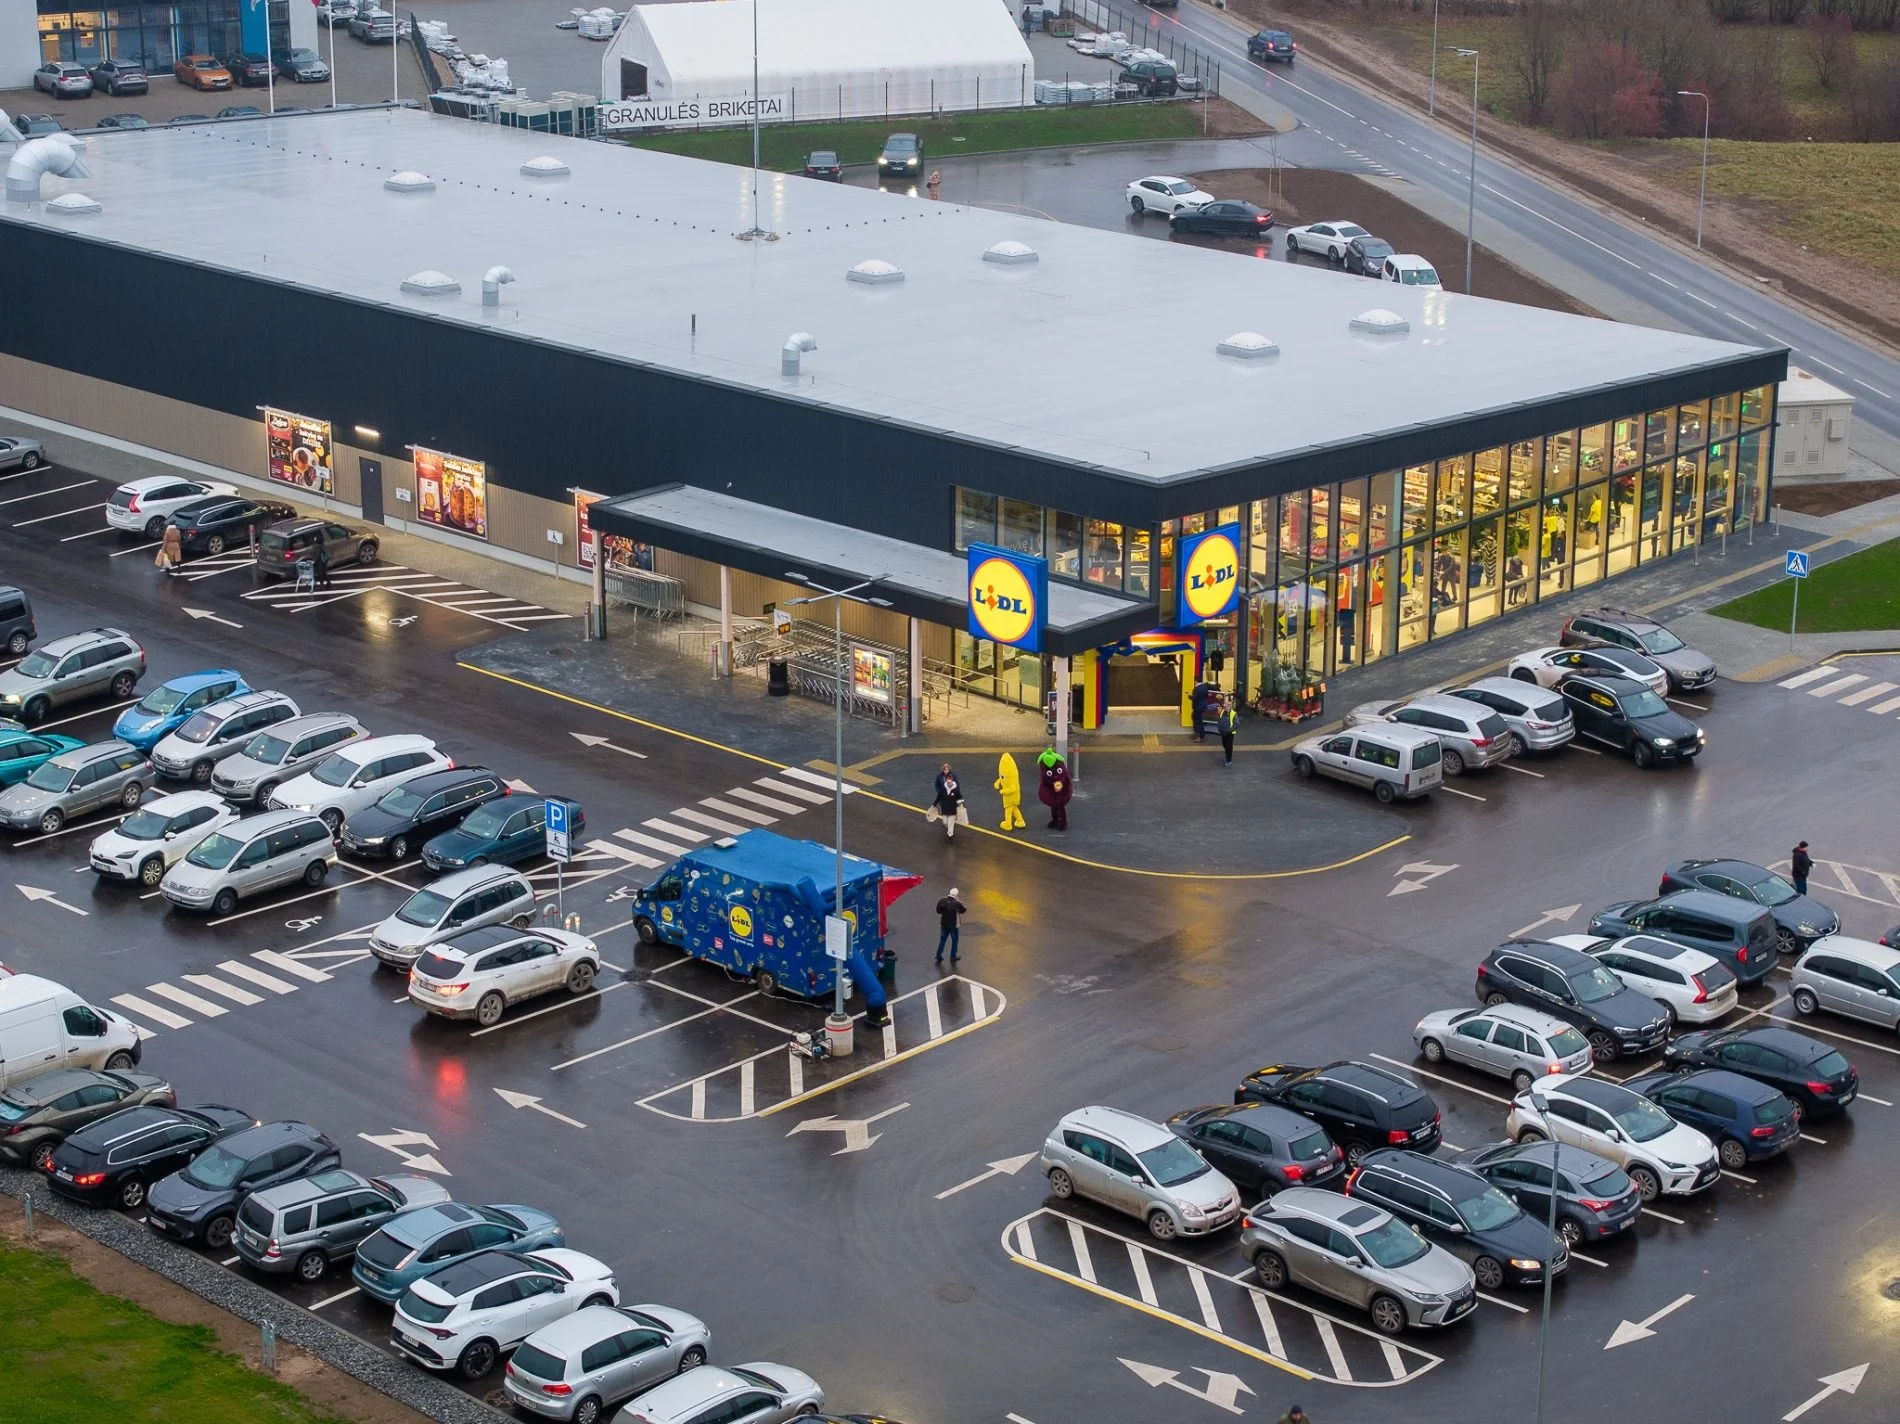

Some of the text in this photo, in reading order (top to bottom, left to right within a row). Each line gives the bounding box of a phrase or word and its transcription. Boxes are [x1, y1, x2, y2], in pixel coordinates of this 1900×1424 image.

[608, 99, 781, 124] GRANULĖS BRIKETAI
[1191, 564, 1235, 590] LIDL
[975, 585, 1027, 614] LIDL
[551, 805, 563, 827] P
[731, 915, 751, 928] LIDL
